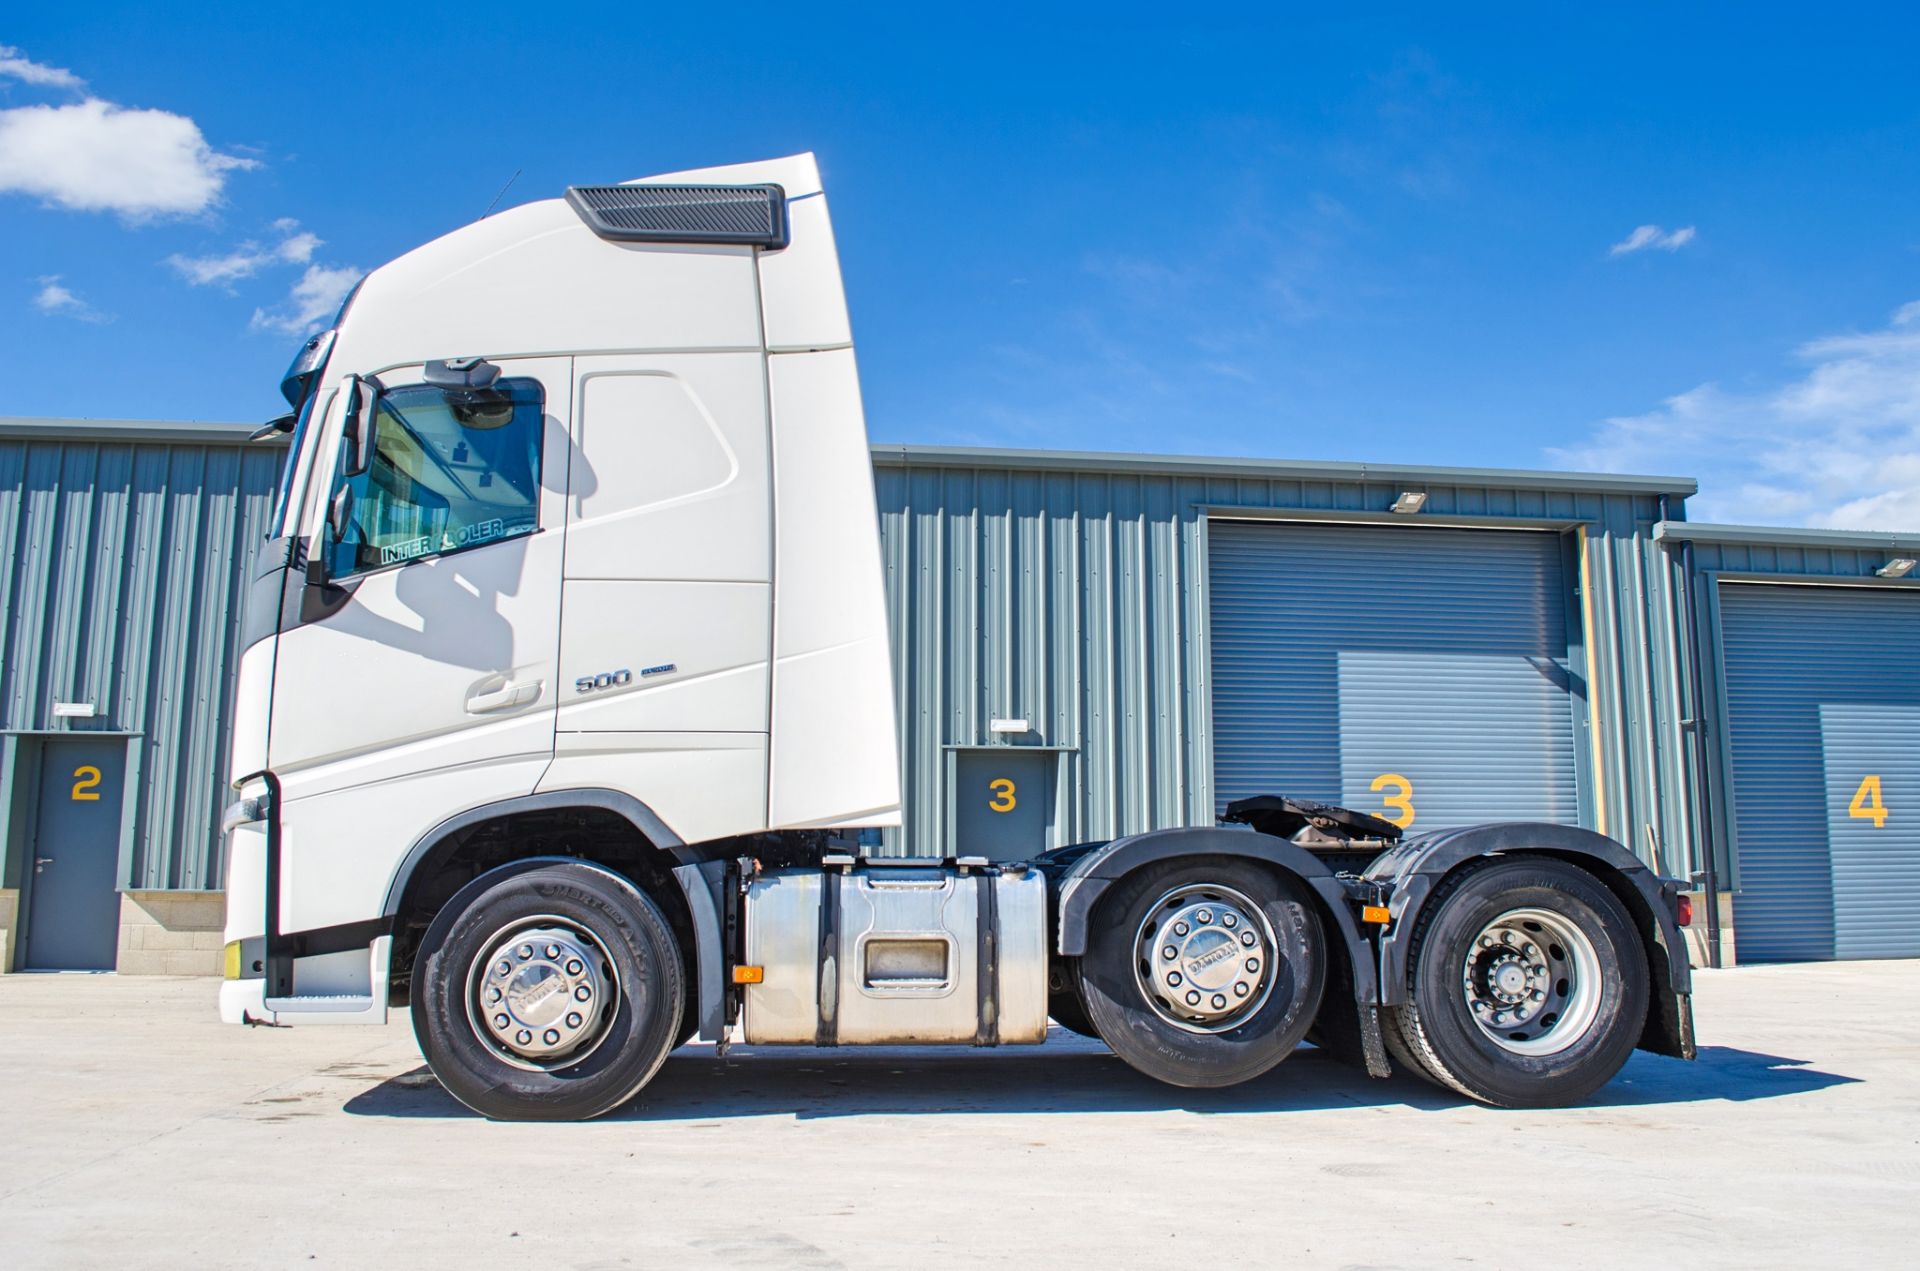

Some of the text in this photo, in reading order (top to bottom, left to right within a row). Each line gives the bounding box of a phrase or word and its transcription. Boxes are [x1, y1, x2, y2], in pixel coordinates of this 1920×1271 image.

[576, 669, 632, 694] 500
[72, 765, 101, 801] 2
[990, 778, 1016, 812] 3
[1370, 773, 1415, 830] 3
[1849, 776, 1889, 828] 4
